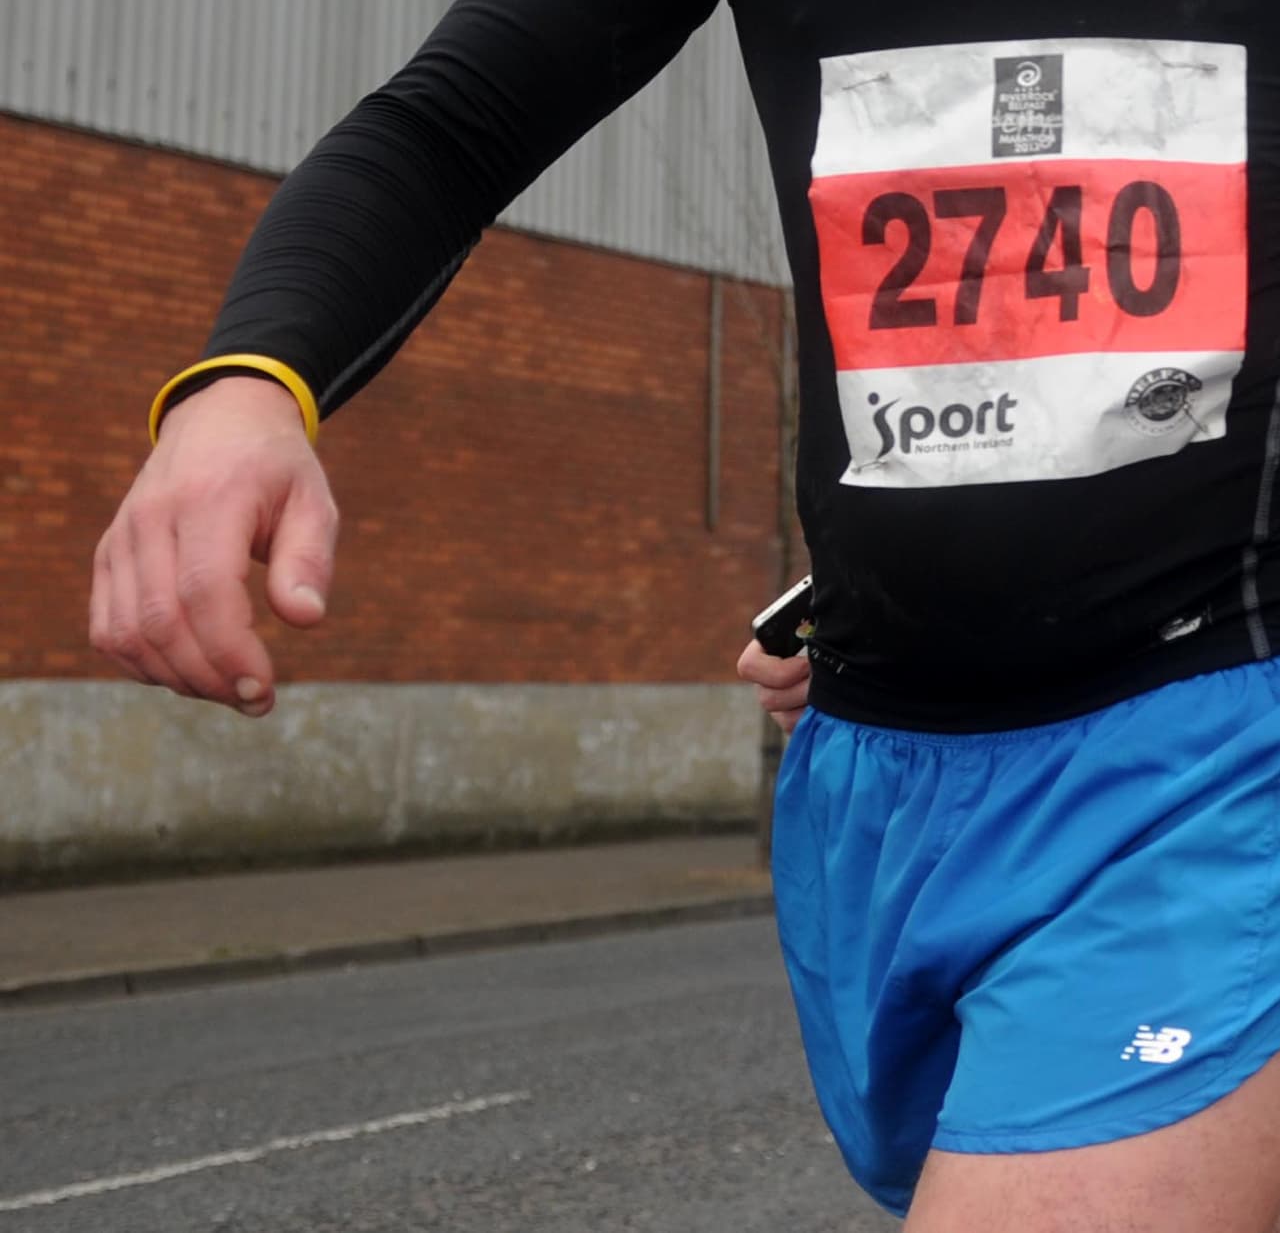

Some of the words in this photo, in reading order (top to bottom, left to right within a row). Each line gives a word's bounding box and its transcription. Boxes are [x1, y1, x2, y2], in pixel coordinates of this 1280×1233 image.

[862, 181, 1182, 331] 2740
[915, 441, 970, 454] Northern
[973, 437, 1014, 450] Ireland
